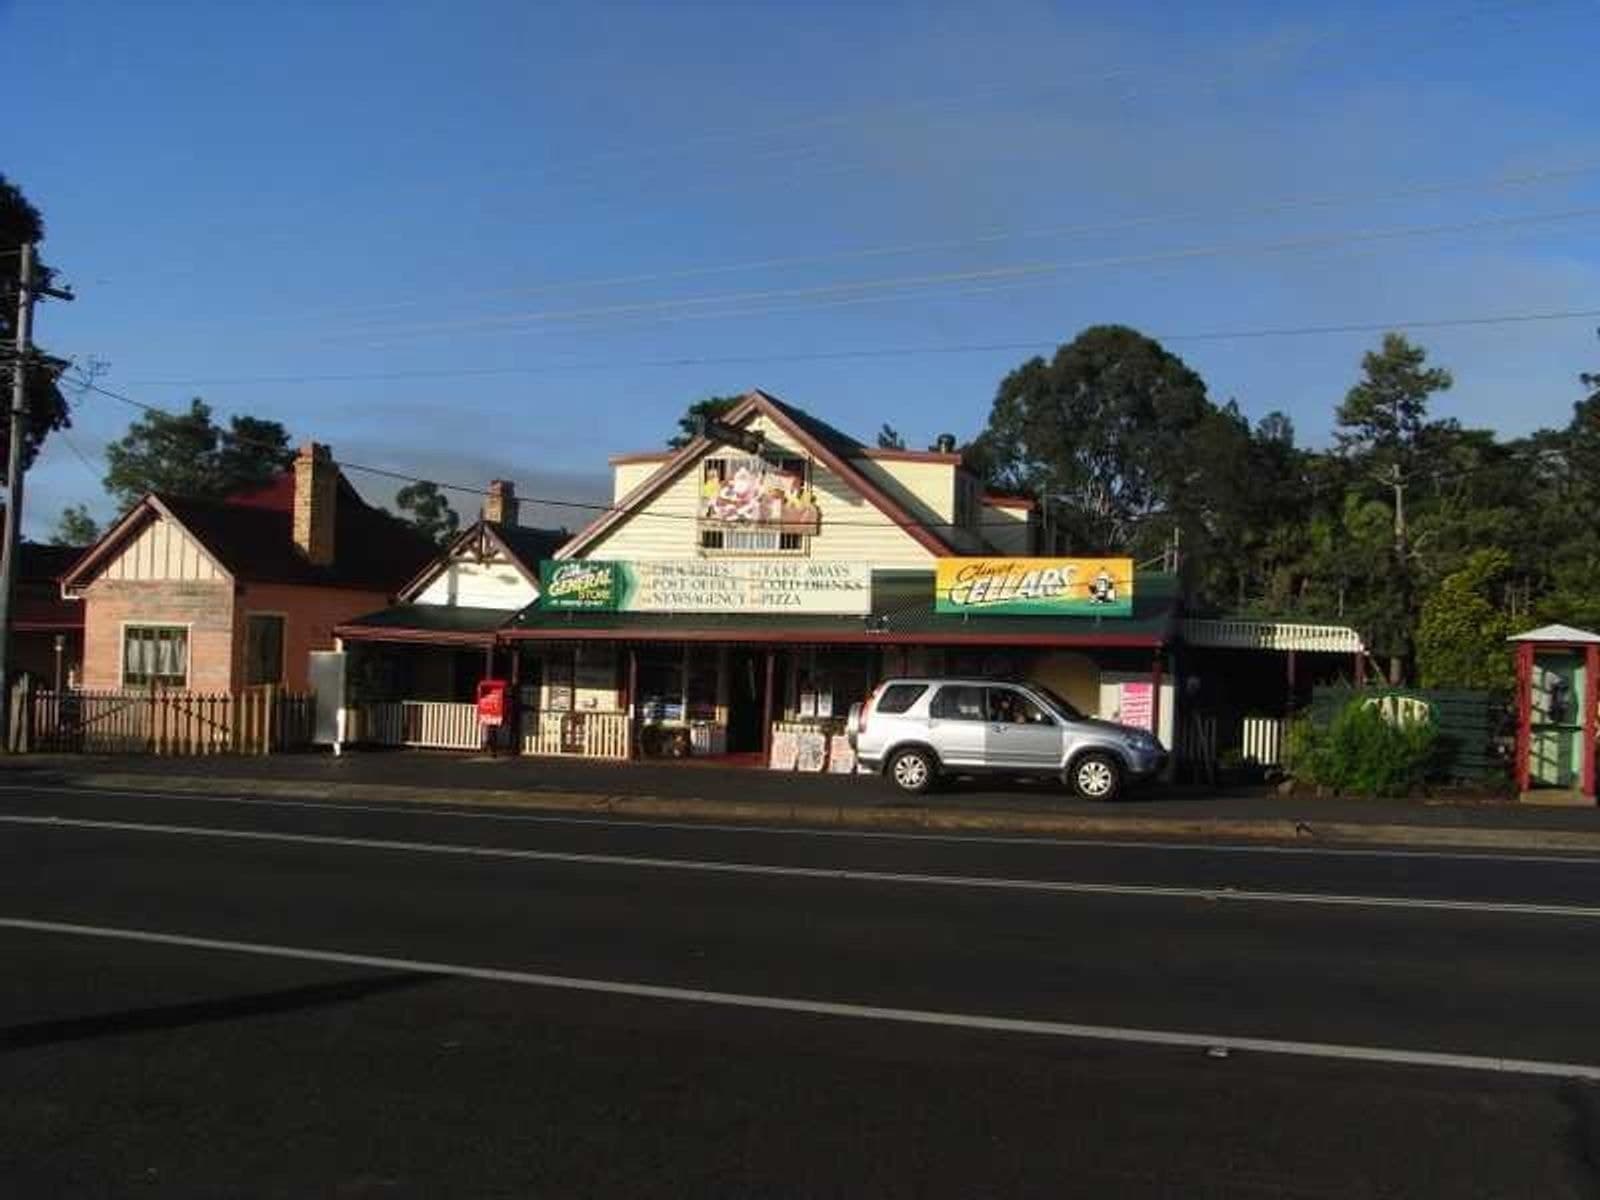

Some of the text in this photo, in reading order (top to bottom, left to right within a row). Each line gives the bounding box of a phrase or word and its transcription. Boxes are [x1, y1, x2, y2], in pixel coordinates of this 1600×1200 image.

[763, 563, 799, 577] TAKE
[653, 578, 737, 591] POST OFFICE
[762, 579, 799, 591] COLD
[948, 564, 1078, 606] CELLARS
[653, 591, 745, 605] NEWSAGENCY
[763, 592, 801, 605] PIZZA
